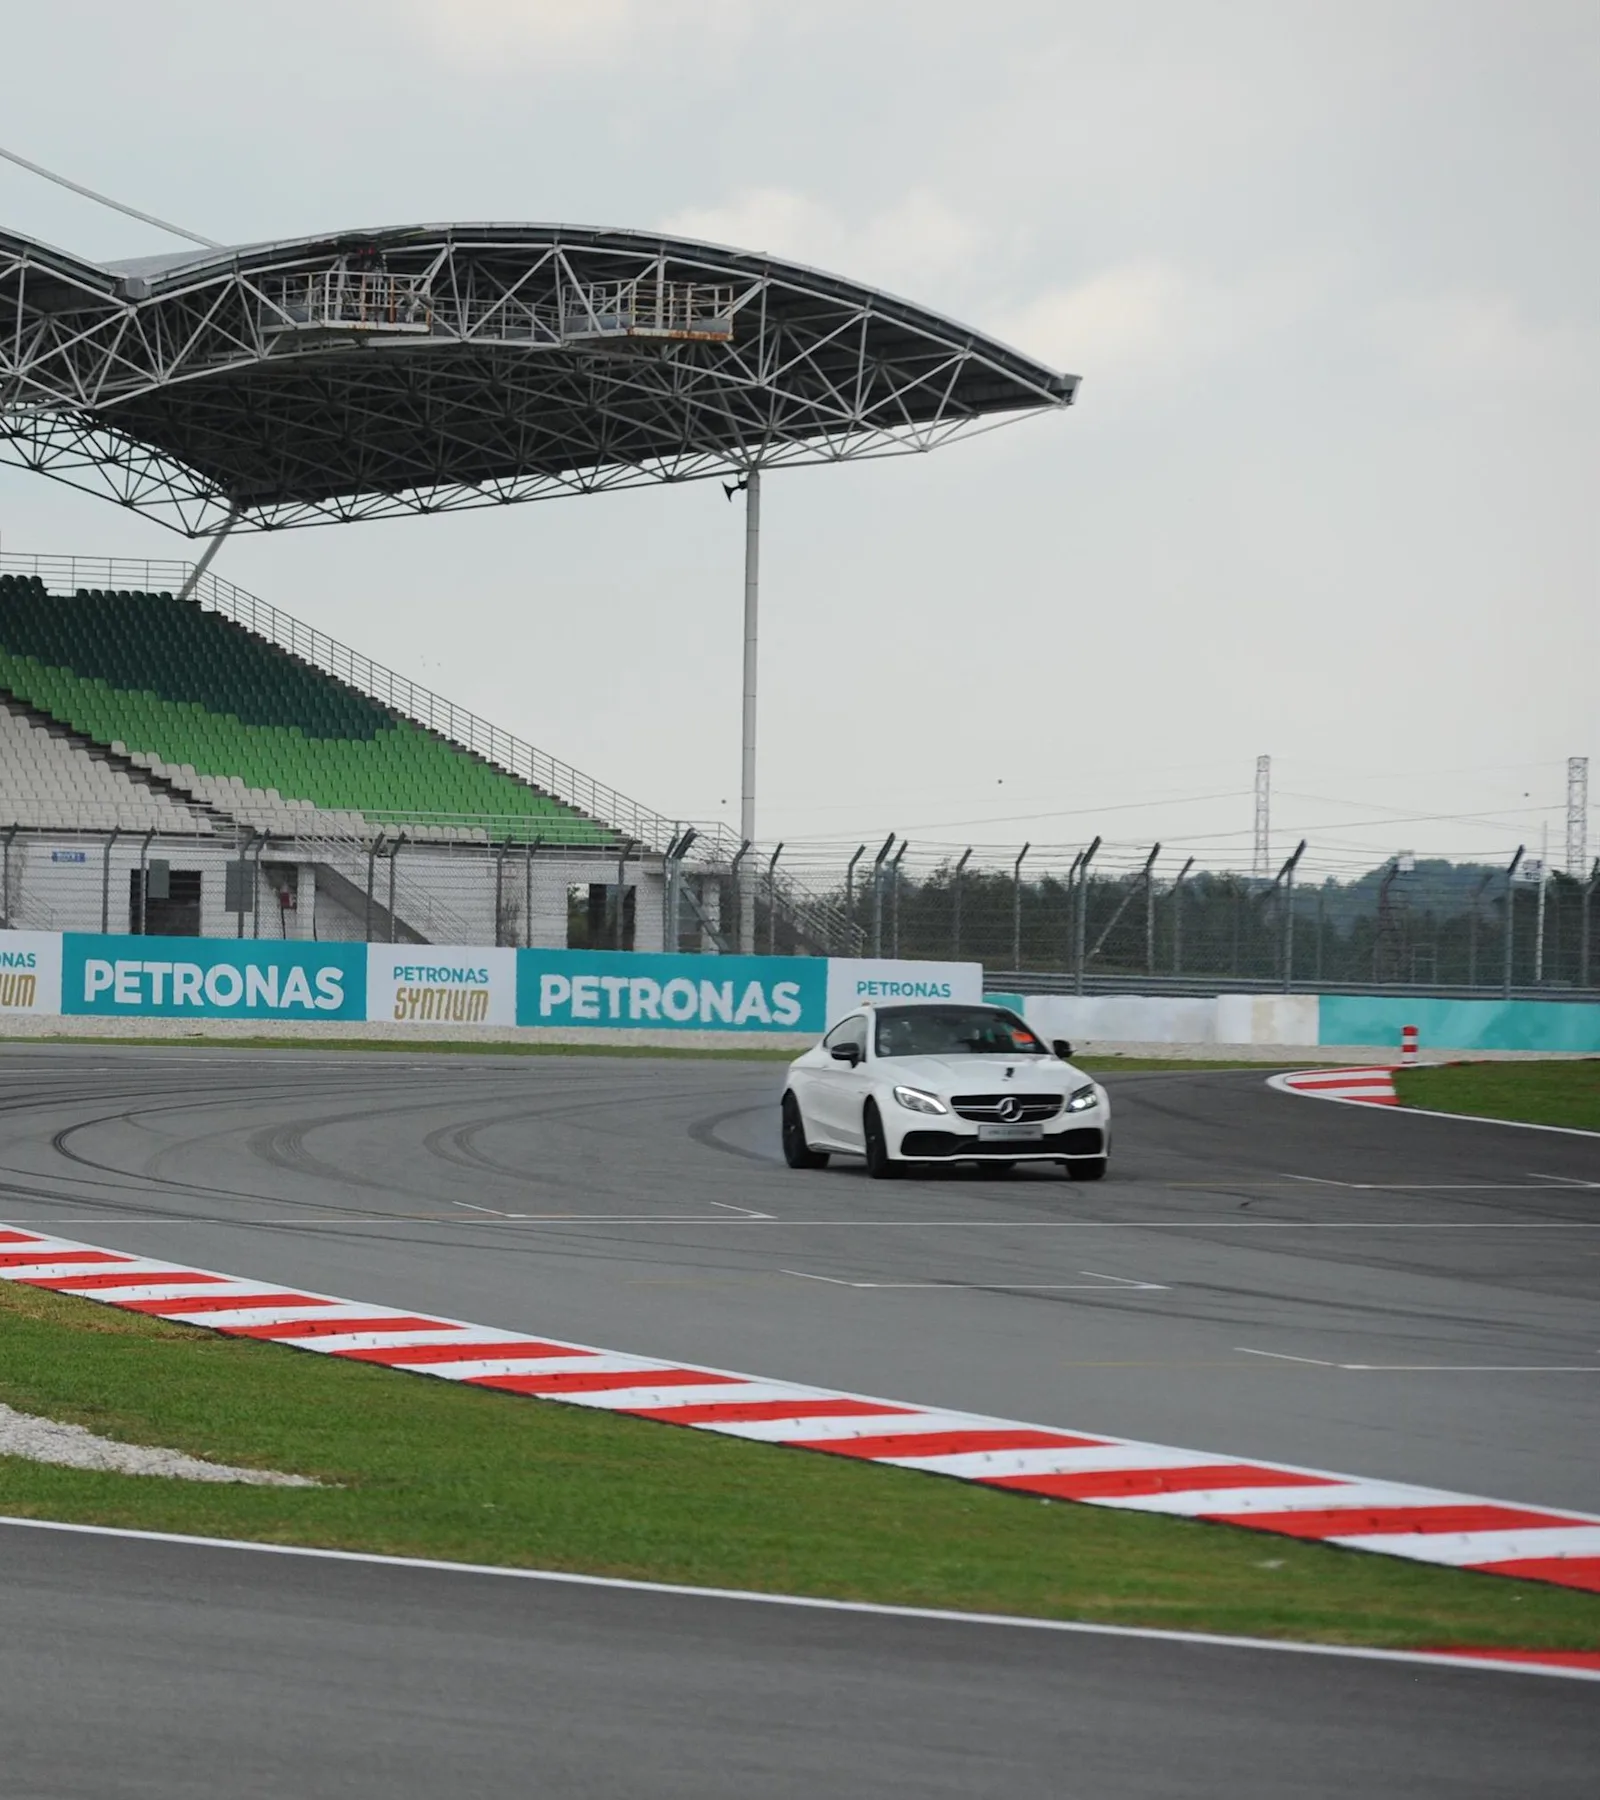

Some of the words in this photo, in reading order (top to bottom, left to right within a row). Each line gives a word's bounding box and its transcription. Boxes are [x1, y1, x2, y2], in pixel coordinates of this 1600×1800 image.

[84, 959, 344, 1010] PETRONAS
[393, 966, 489, 984] PETRONAS
[857, 981, 951, 998] PETRONAS
[393, 988, 488, 1021] SYNTIUM
[539, 973, 802, 1025] PETRONAS
